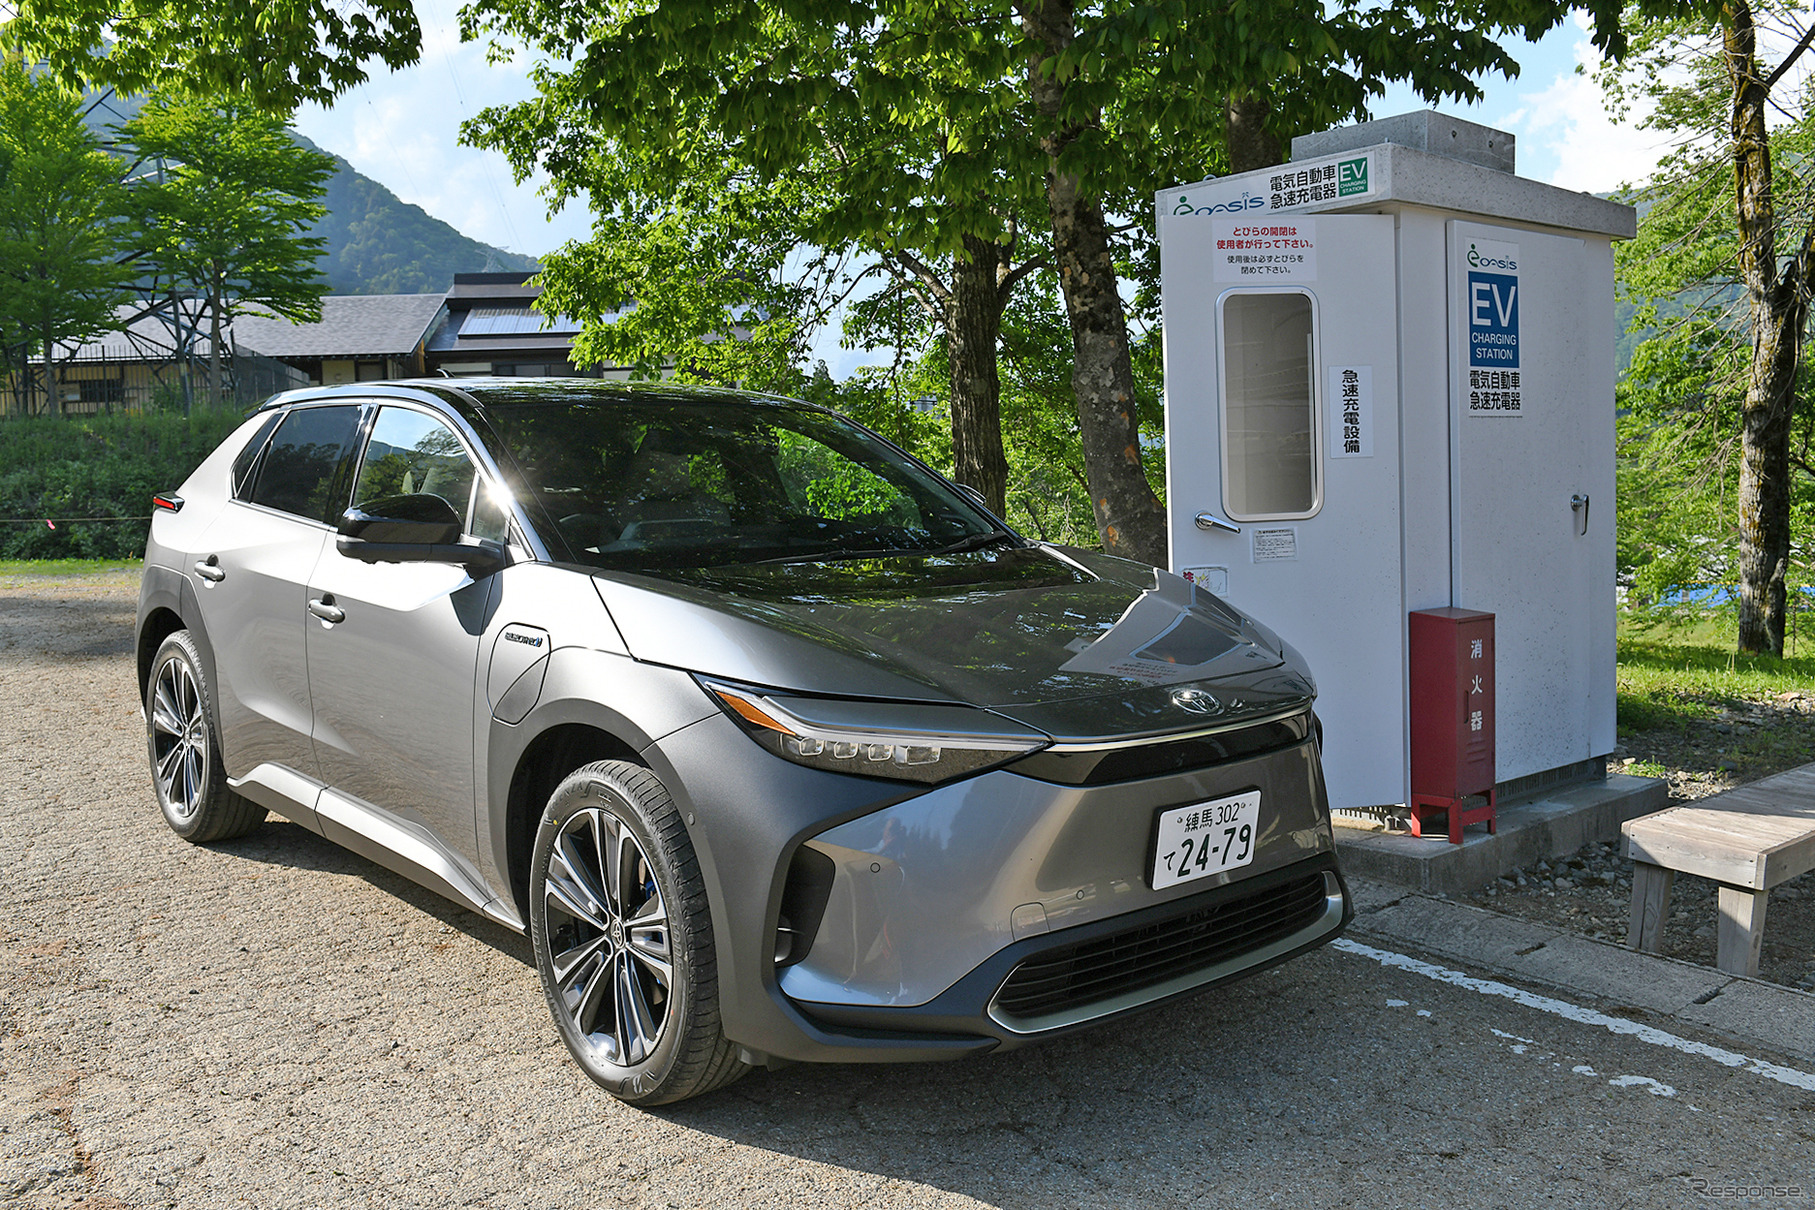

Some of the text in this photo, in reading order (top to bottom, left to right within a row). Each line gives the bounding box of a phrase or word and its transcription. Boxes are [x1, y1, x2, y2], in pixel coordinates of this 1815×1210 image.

[1269, 165, 1336, 193] 電気自動車
[1339, 160, 1367, 182] EV
[1340, 178, 1367, 189] CHARGING
[1342, 185, 1365, 194] STATION
[1270, 182, 1337, 210] 急速充電器
[1232, 226, 1297, 236] とびらの開閉は
[1216, 239, 1315, 250] 使用者が行って下さい。
[1241, 266, 1291, 274] 閉めて下さい。
[1471, 281, 1517, 328] EV
[1471, 332, 1517, 346] CHARGING
[1475, 348, 1513, 360] STATION
[1469, 370, 1521, 390] 電気自動車
[1469, 390, 1521, 411] 急速充電器
[1342, 369, 1360, 454] 急速充電設備
[1470, 639, 1483, 732] 消火器
[1184, 802, 1240, 833] 練馬 302
[1163, 823, 1252, 877] て 24-79
